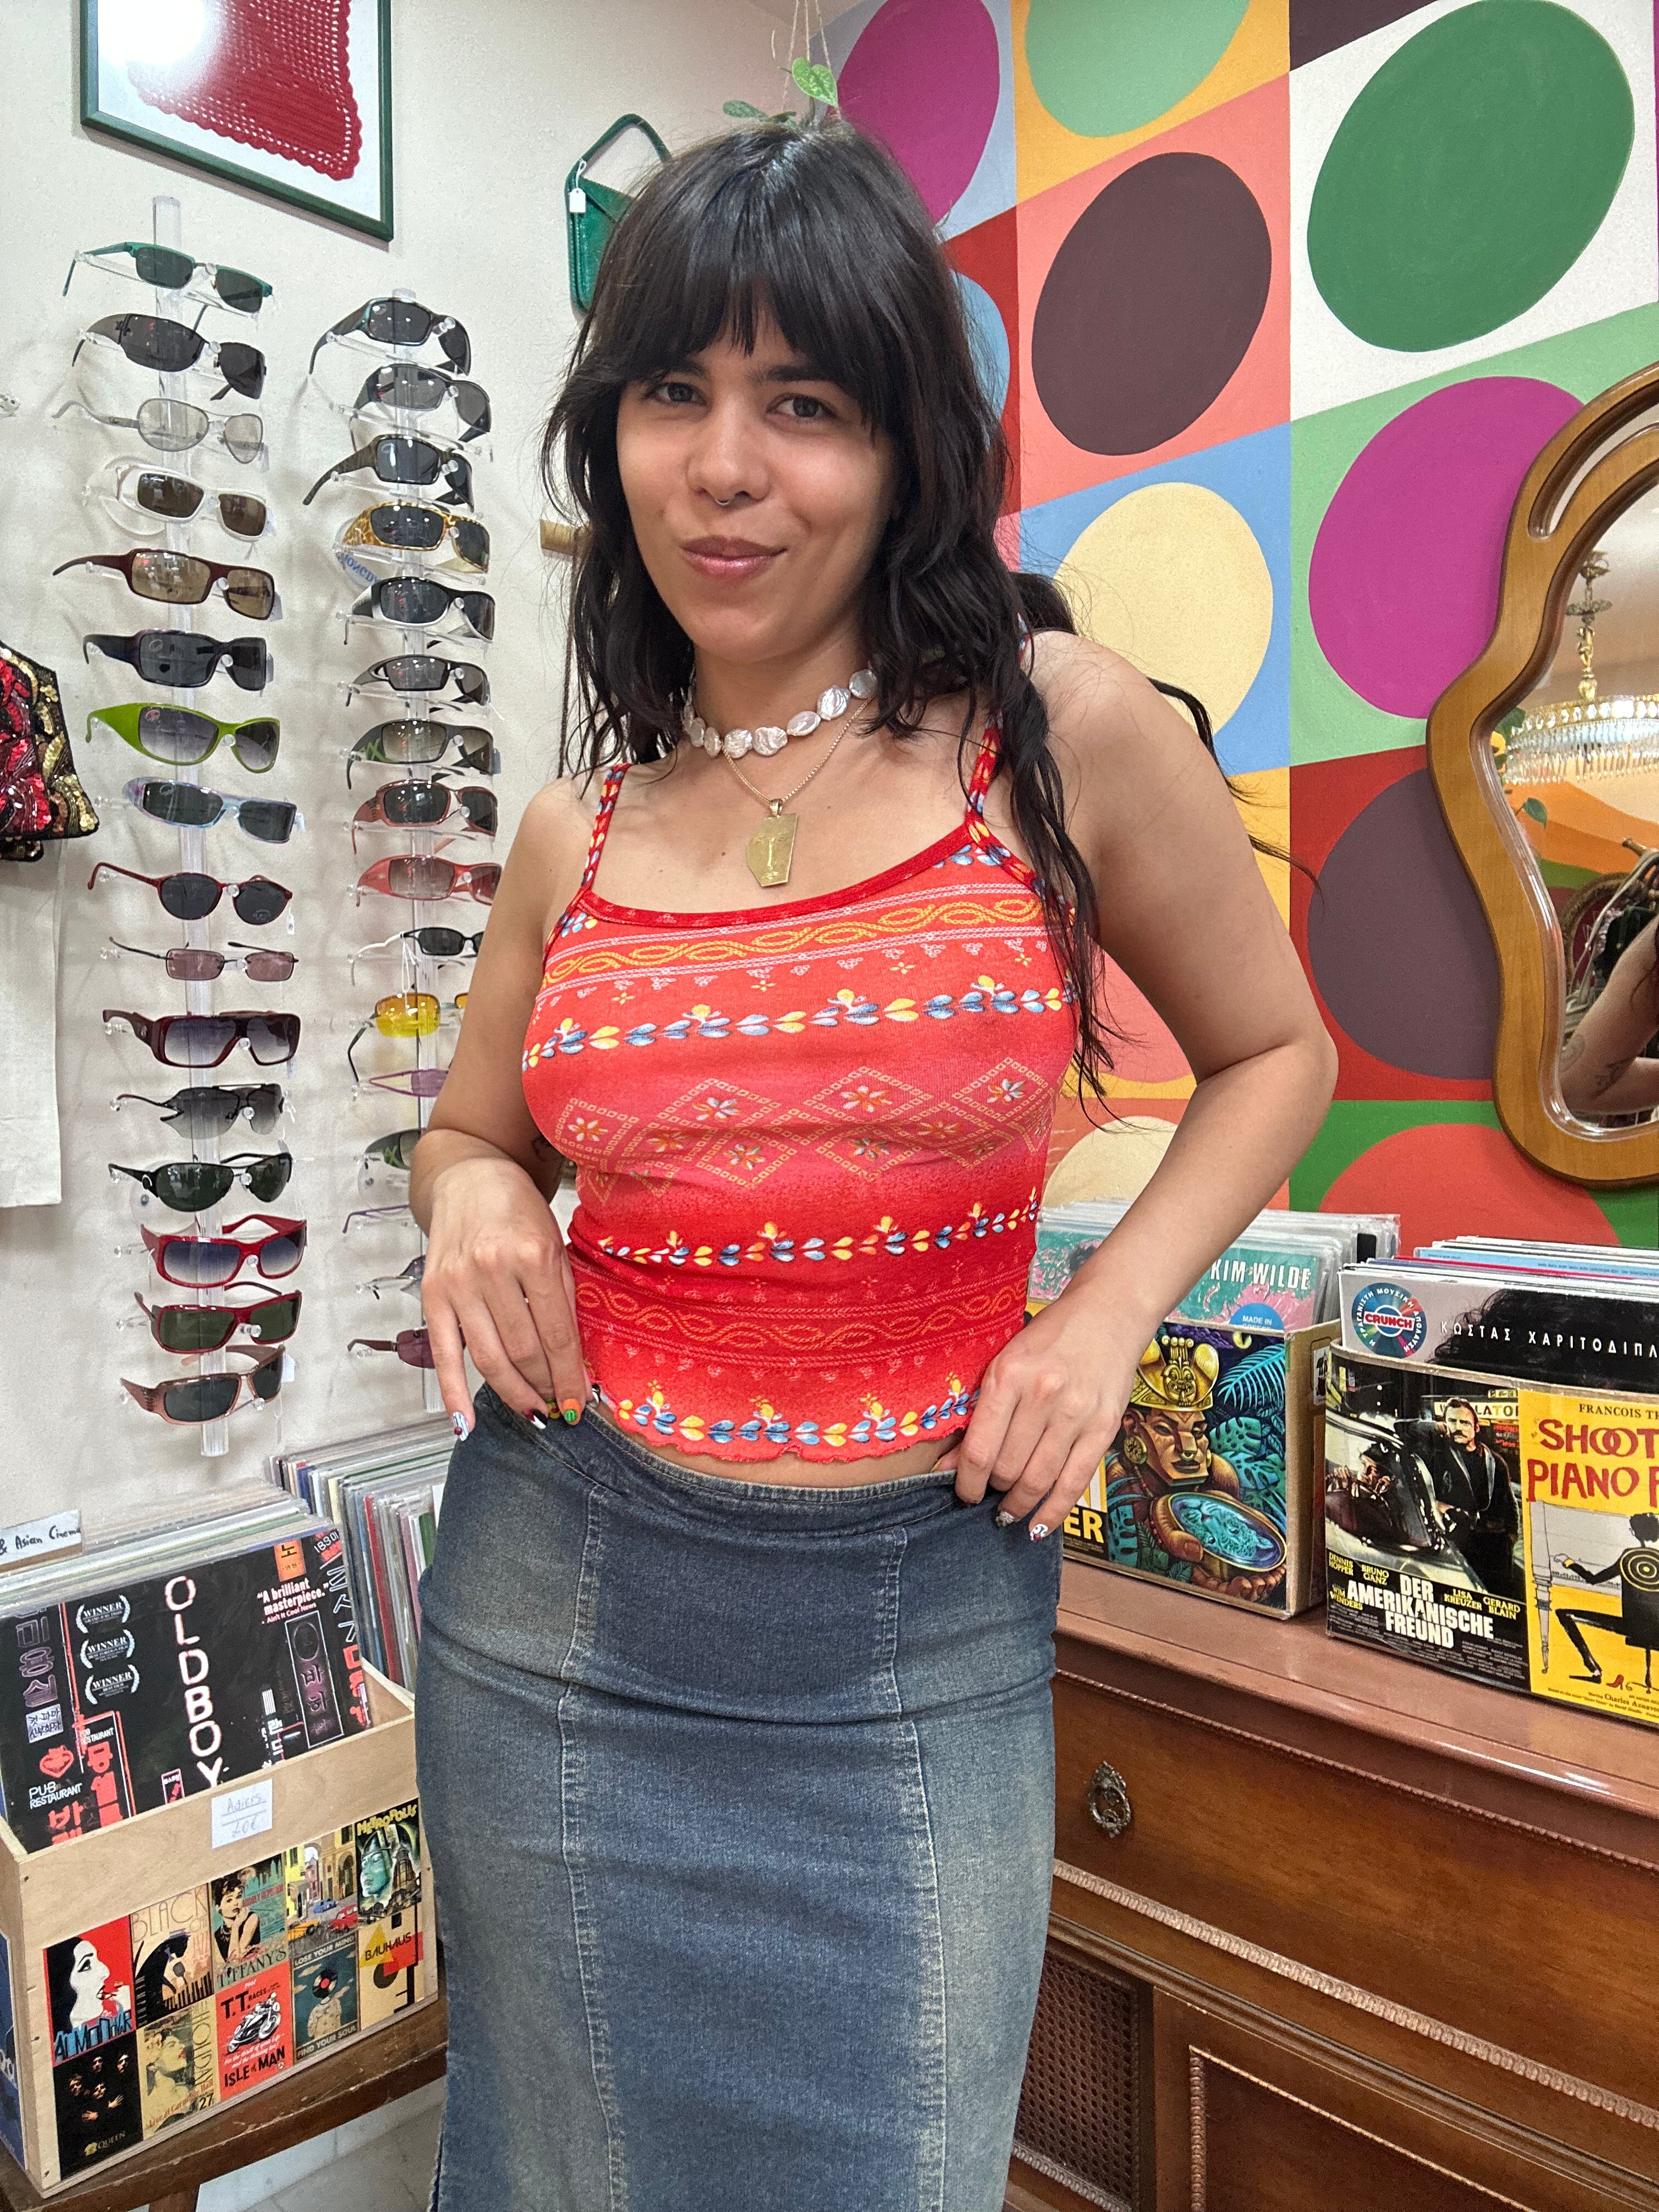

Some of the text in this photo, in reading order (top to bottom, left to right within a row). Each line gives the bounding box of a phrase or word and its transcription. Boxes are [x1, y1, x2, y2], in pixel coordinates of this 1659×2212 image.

[1210, 1259, 1311, 1290] KIM WILDE
[1243, 1316, 1262, 1324] MADE
[1365, 1313, 1412, 1329] CRUNCH
[1376, 1288, 1414, 1308] ΜΟΥΣΙΚΗ
[1403, 1311, 1423, 1352] ΑΠΟΛΑΥΣΗ
[1441, 1321, 1510, 1341] ΚΩΣΤΑΣ
[1579, 1404, 1641, 1418] FRANCOIS
[1539, 1419, 1659, 1459] SHOOT
[1526, 1458, 1640, 1503] PIANO
[15, 1534, 43, 1550] Asian
[1362, 1564, 1389, 1578] BRUNO
[1363, 1572, 1387, 1585] GANZ
[272, 1577, 311, 1599] brilliant
[1400, 1573, 1435, 1603] DER
[1453, 1588, 1472, 1601] LISA
[83, 1601, 122, 1617] WINNER
[286, 1606, 300, 1617] Cool
[300, 1602, 317, 1612] News
[1329, 1591, 1363, 1611] WENDERS
[1347, 1579, 1494, 1640] AMERIKANISCHE
[1444, 1594, 1482, 1611] KREUZER
[1483, 1596, 1521, 1613] GERARD
[1488, 1607, 1517, 1621] BLAIN
[1385, 1610, 1454, 1649] FREUND
[87, 1636, 128, 1653] WINNER
[93, 1672, 132, 1689] WINNER
[165, 1576, 222, 1788] OLDBOY
[1604, 1694, 1630, 1706] Charles
[29, 1781, 57, 1799] PUB
[30, 1783, 83, 1809] RESTAURANT
[357, 1804, 417, 1836] METROPOLIS
[131, 1884, 208, 1944] BLACK
[294, 1934, 355, 1967] LOSE YOUR MIND
[365, 1932, 412, 1962] BAUHAUS
[221, 1989, 251, 2019] T.T.
[248, 1988, 267, 2001] RACES
[192, 2010, 214, 2085] HOLIDAY
[297, 2024, 357, 2058] FIND YOUR SOUL
[224, 2064, 250, 2087] ISLE
[258, 2045, 285, 2072] MAN
[199, 2092, 214, 2112] 27
